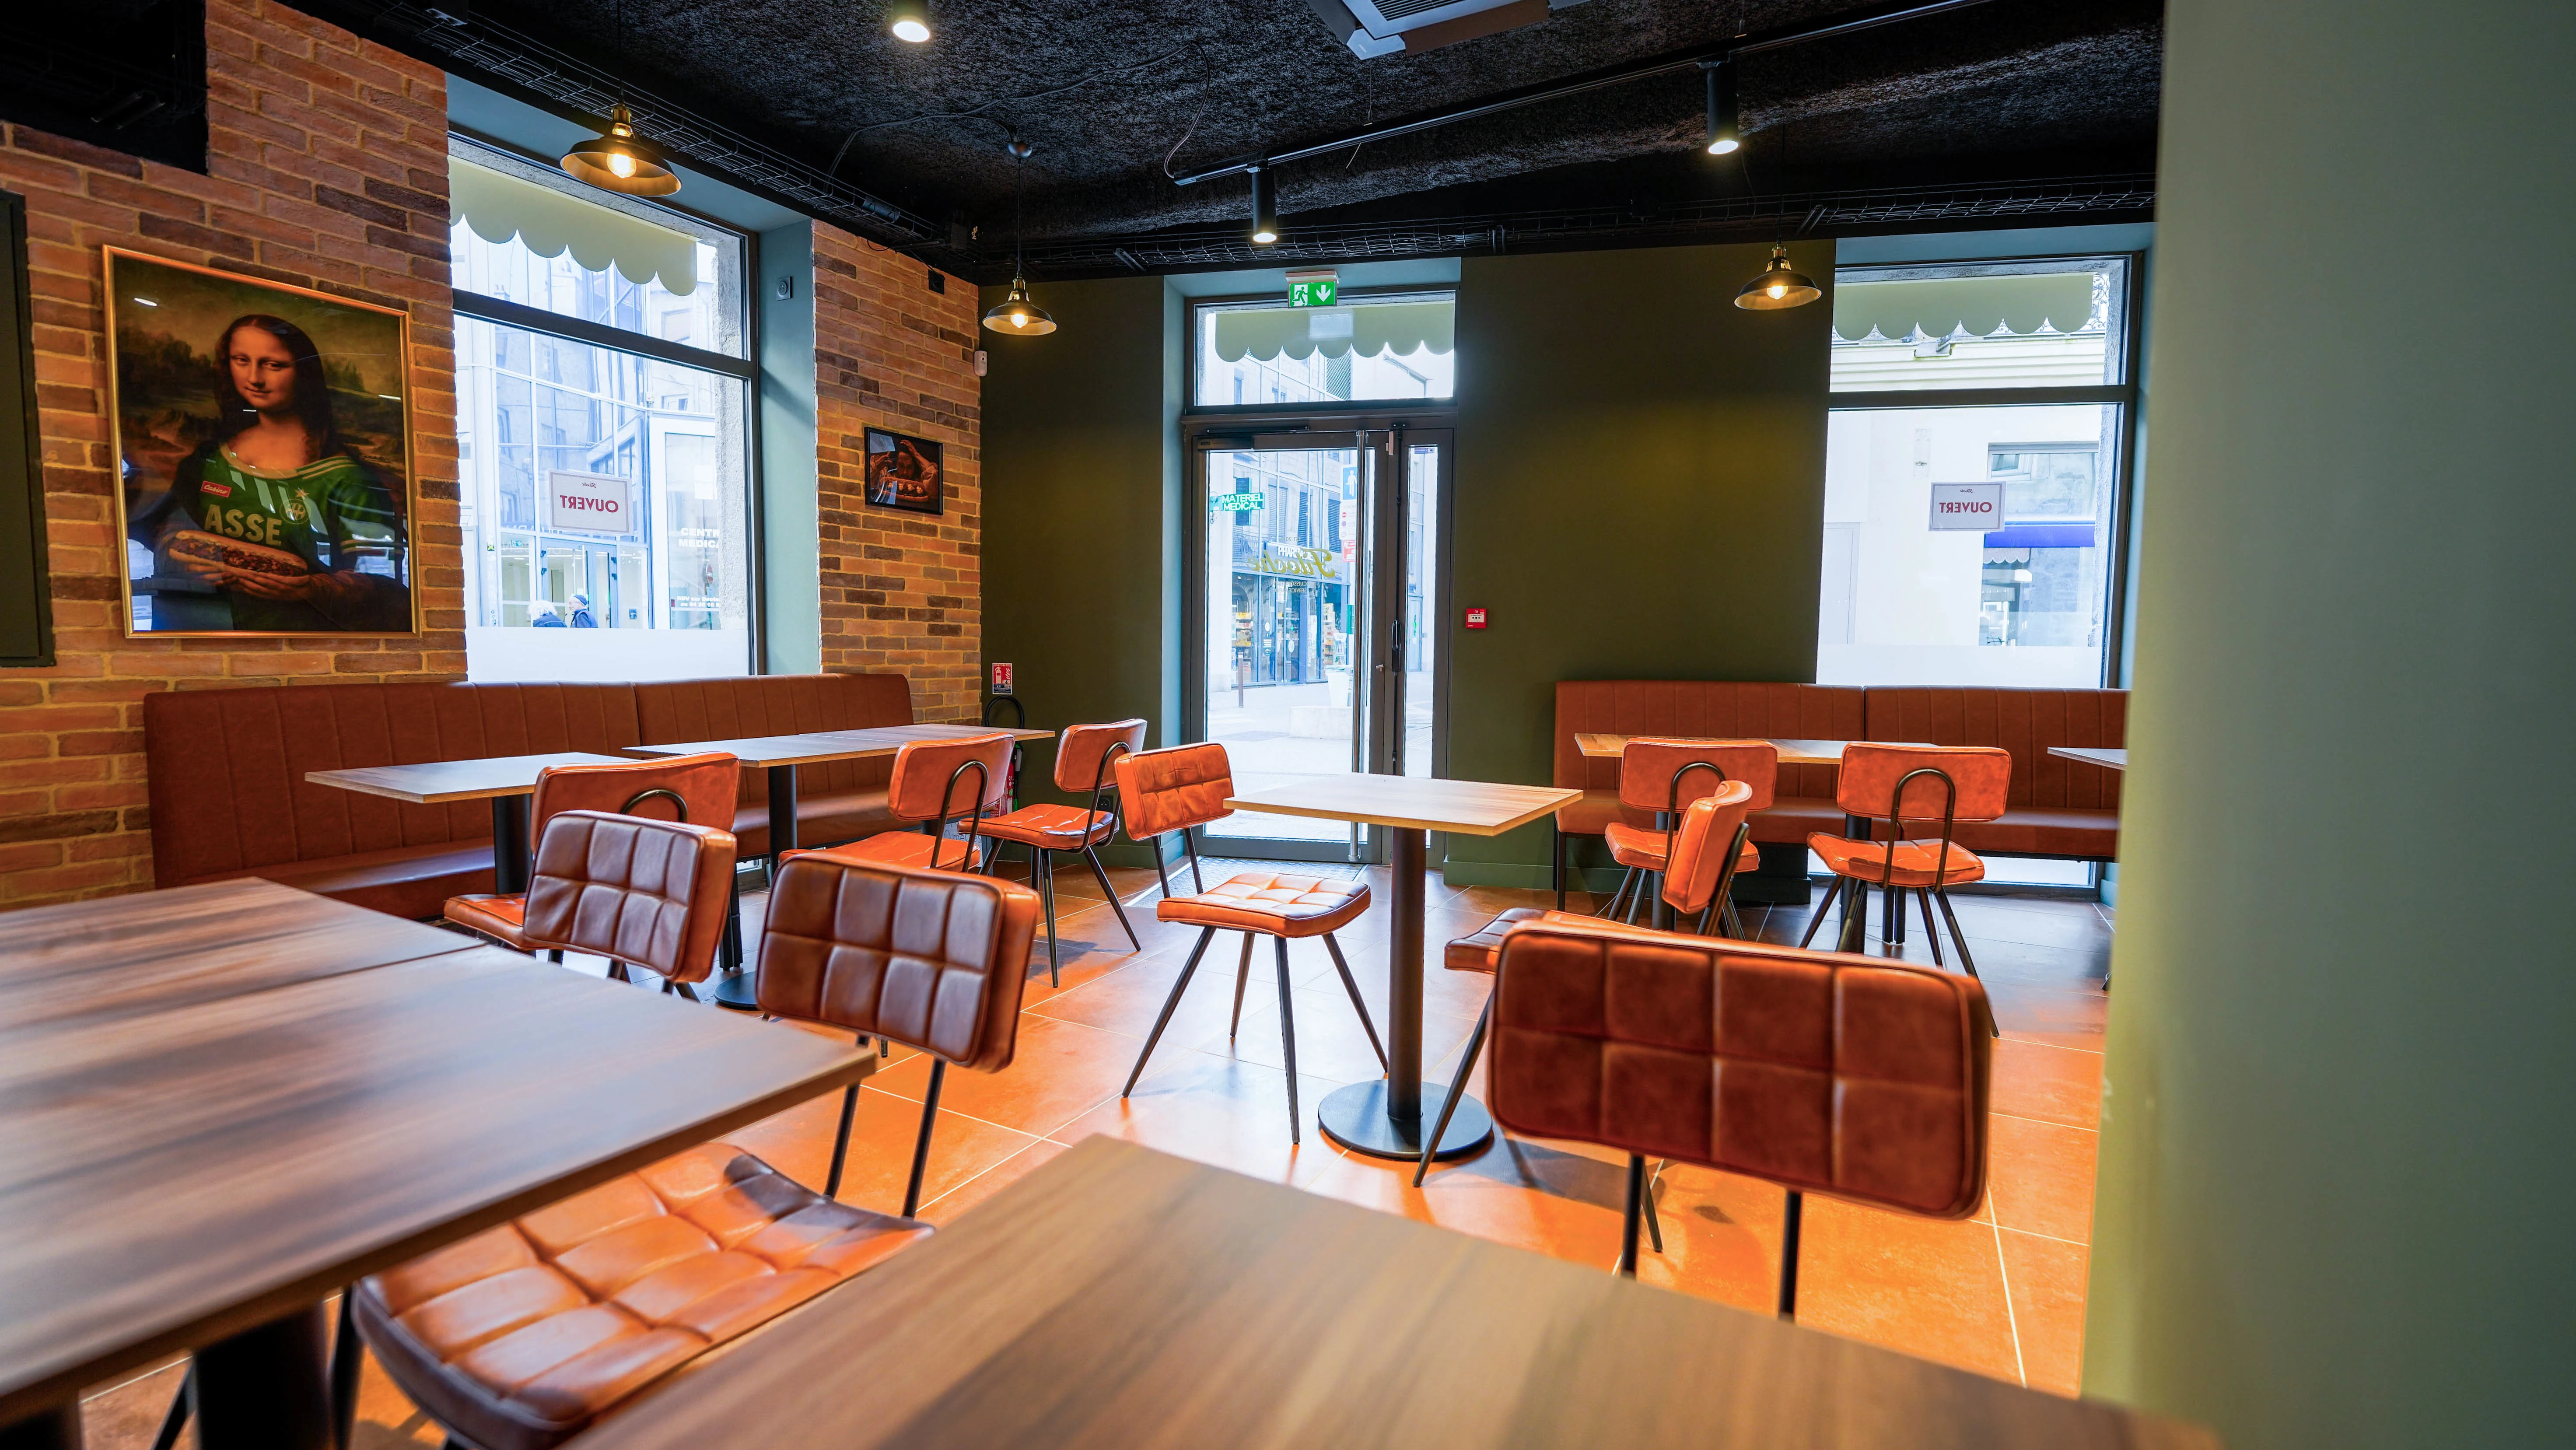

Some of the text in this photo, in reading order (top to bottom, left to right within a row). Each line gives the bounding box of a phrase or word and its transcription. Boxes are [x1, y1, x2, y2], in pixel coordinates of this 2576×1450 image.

[1222, 493, 1263, 503] MATERIEL
[1224, 501, 1261, 511] MEDICAL
[204, 504, 282, 546] ASSE
